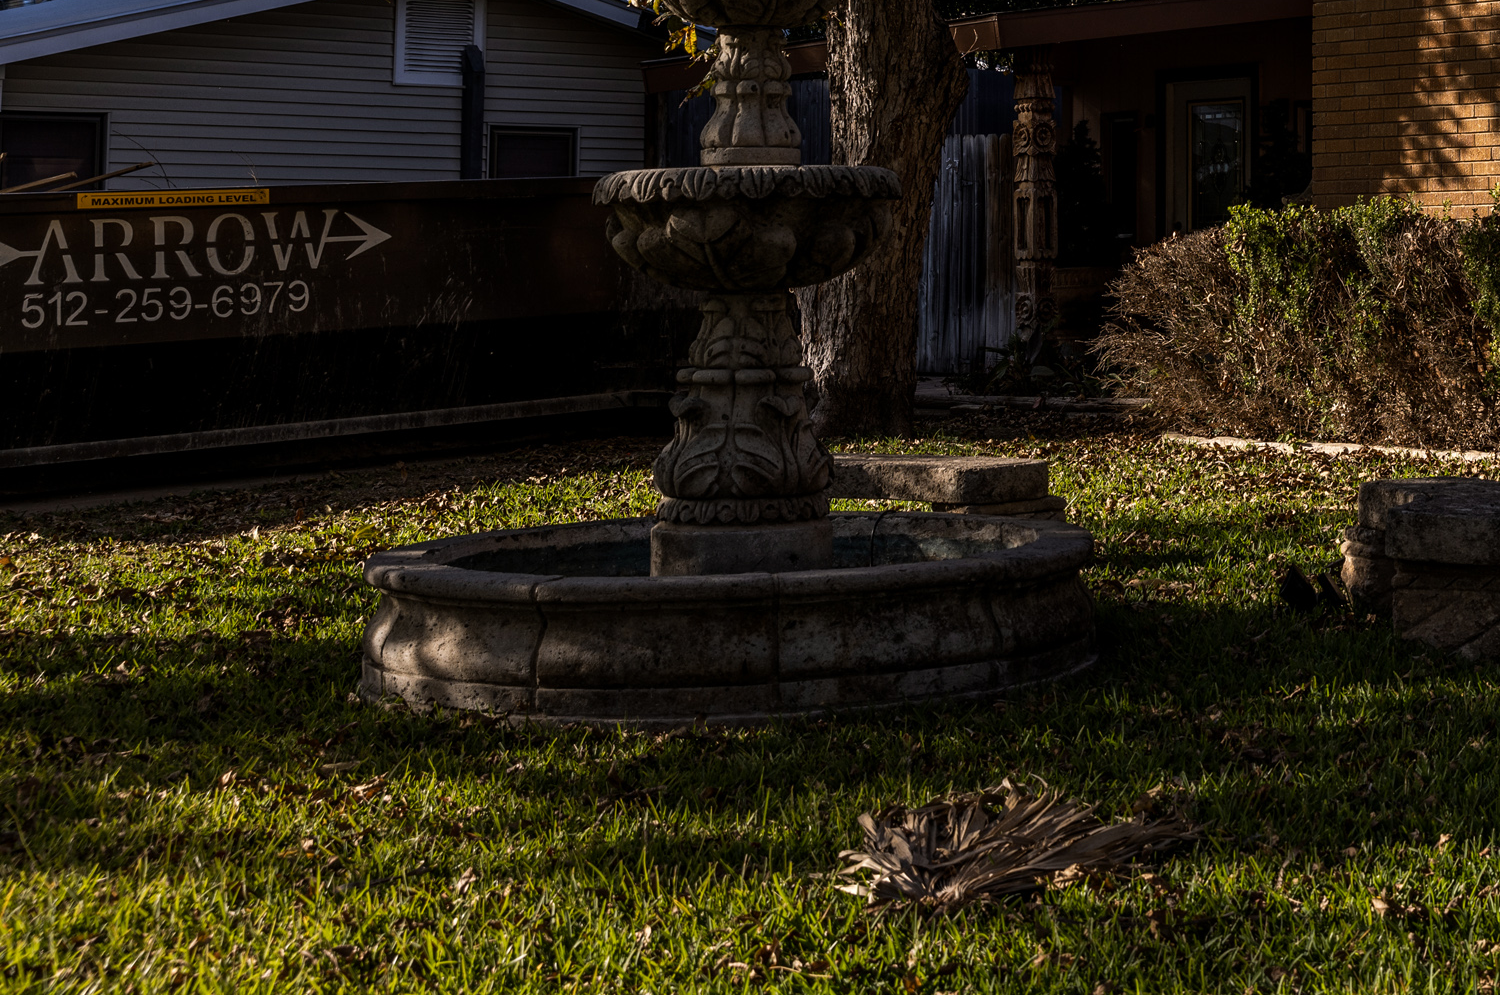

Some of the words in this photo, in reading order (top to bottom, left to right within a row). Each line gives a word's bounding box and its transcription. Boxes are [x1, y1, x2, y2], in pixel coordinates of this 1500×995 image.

[91, 196, 155, 206] MAXIMUM
[159, 195, 215, 205] LOADING
[218, 194, 257, 204] LEVEL
[23, 209, 339, 286] ARROW
[21, 280, 310, 328] 512-259-6979
